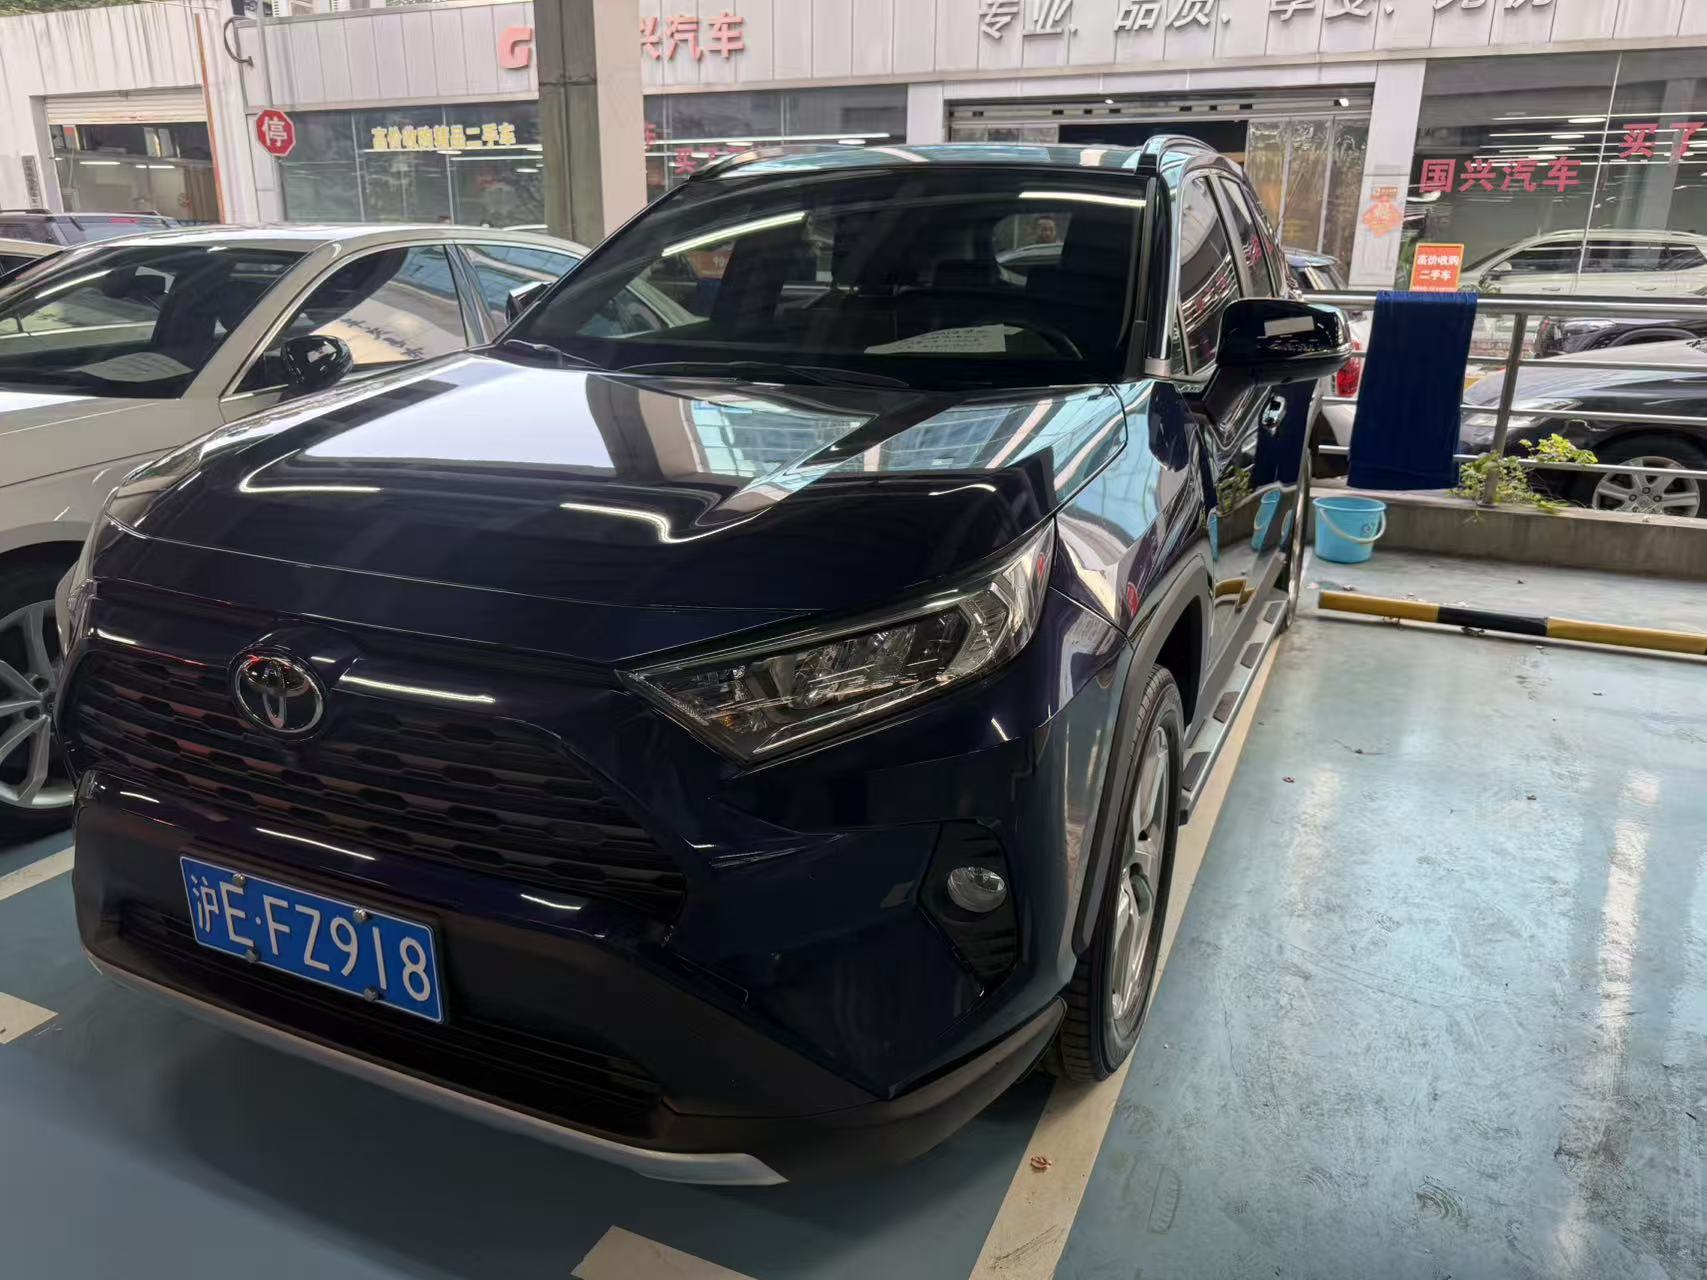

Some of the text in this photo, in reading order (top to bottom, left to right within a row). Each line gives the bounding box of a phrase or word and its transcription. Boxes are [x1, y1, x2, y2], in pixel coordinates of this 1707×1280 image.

[261, 116, 288, 147] 停
[1420, 157, 1582, 193] 国兴汽车
[1416, 255, 1460, 266] 高价收购
[1418, 269, 1452, 281] 二手车
